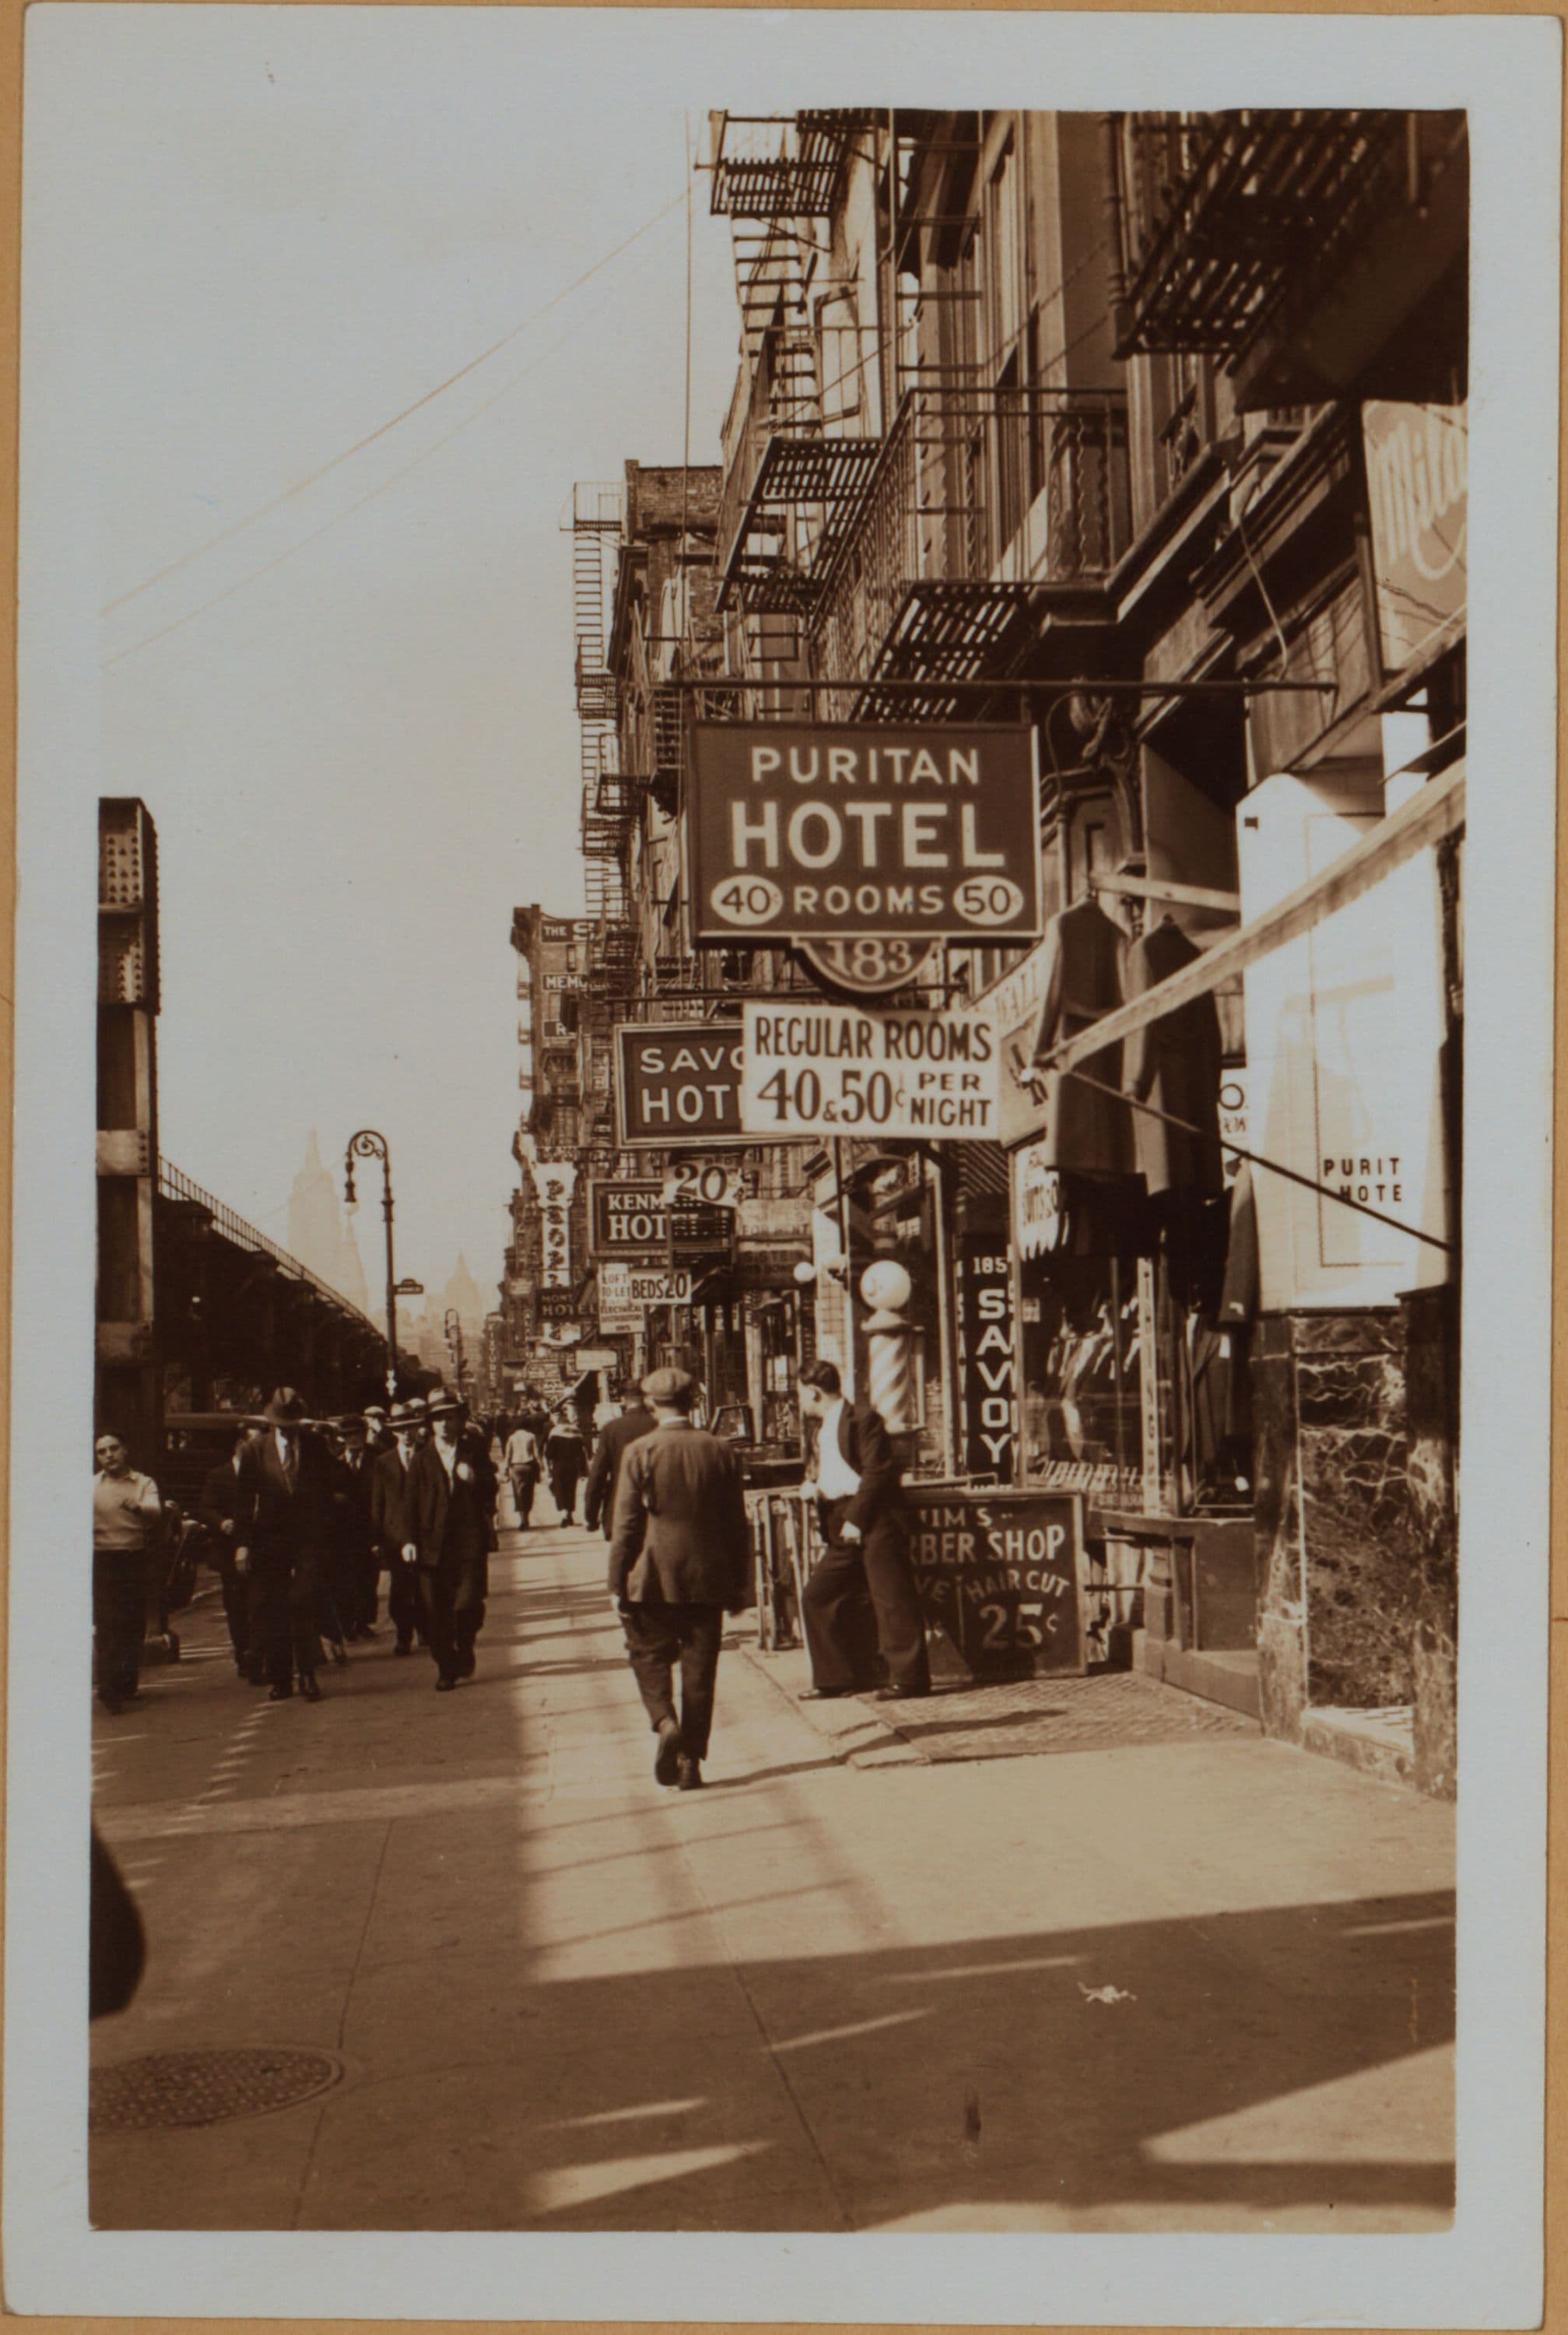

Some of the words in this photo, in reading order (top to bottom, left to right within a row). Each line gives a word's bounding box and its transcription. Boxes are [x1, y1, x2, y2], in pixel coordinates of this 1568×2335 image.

[752, 747, 980, 784] PURITAN
[730, 801, 1005, 869] HOTEL
[720, 885, 772, 915] 40
[793, 885, 945, 915] ROOMS
[961, 886, 1011, 915] 50
[544, 925, 567, 936] THE
[826, 938, 913, 983] 183
[755, 1016, 875, 1059] REGULAR
[884, 1020, 992, 1062] ROOMS
[918, 1073, 982, 1091] PER
[641, 1083, 745, 1123] HOT
[910, 1097, 992, 1127] NIGHT
[1324, 1157, 1400, 1178] PURIT
[1339, 1184, 1402, 1203] HOTE
[608, 1214, 688, 1241] HOT
[973, 1257, 1009, 1275] 185
[631, 1279, 664, 1301] BEDS
[976, 1288, 1012, 1464] SAVOY
[988, 1524, 1065, 1561] SHOP
